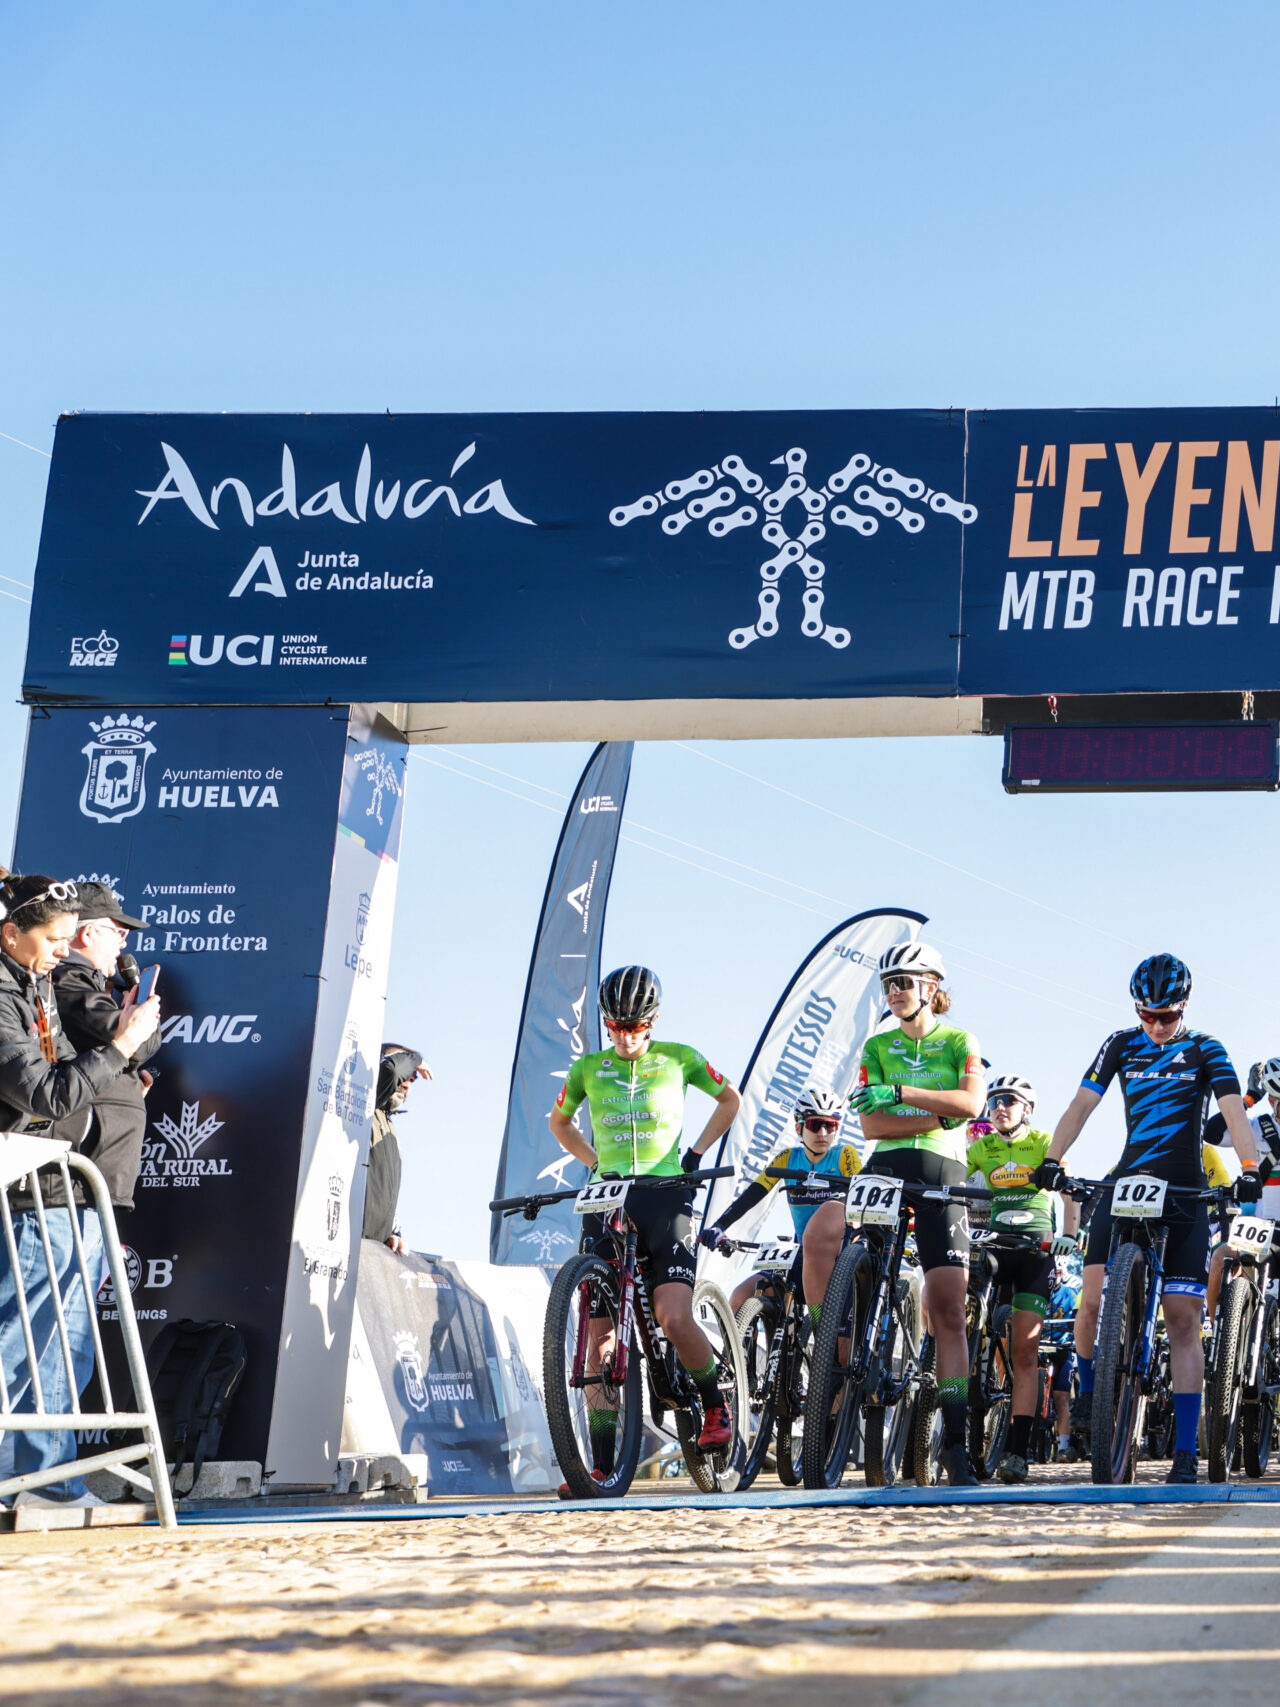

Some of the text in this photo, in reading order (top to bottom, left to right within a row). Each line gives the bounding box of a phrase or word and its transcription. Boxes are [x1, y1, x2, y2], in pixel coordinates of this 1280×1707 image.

[1016, 444, 1056, 487] LA
[135, 441, 538, 530] Andalucía
[297, 550, 360, 569] Junta
[295, 567, 434, 591] de Andalucía
[998, 569, 1096, 631] MTB
[1122, 565, 1244, 628] RACE
[282, 635, 318, 645] UNION
[187, 635, 275, 666] UCI
[280, 645, 328, 655] CYCLISTE
[69, 652, 118, 667] RACE
[279, 656, 367, 666] INTERNATIONALE
[162, 767, 283, 782] Ayuntamiento de
[158, 785, 279, 808] HUELVA
[142, 883, 236, 896] Ayuntamiento
[140, 904, 235, 925] Palos de
[136, 931, 267, 952] la Frontera
[344, 944, 372, 979] Lepe
[839, 947, 865, 967] UCI
[889, 1071, 942, 1080] Extremadura
[1125, 1071, 1197, 1081] BULLS
[344, 1106, 364, 1127] Torre
[162, 1158, 232, 1176] RURAL
[142, 1176, 200, 1187] DEL SUR
[851, 1185, 897, 1208] 104
[1117, 1184, 1161, 1202] 102
[1233, 1223, 1269, 1244] 106
[758, 1248, 792, 1261] 114
[102, 1309, 168, 1321] BEINGS
[431, 1383, 475, 1400] HUELVA
